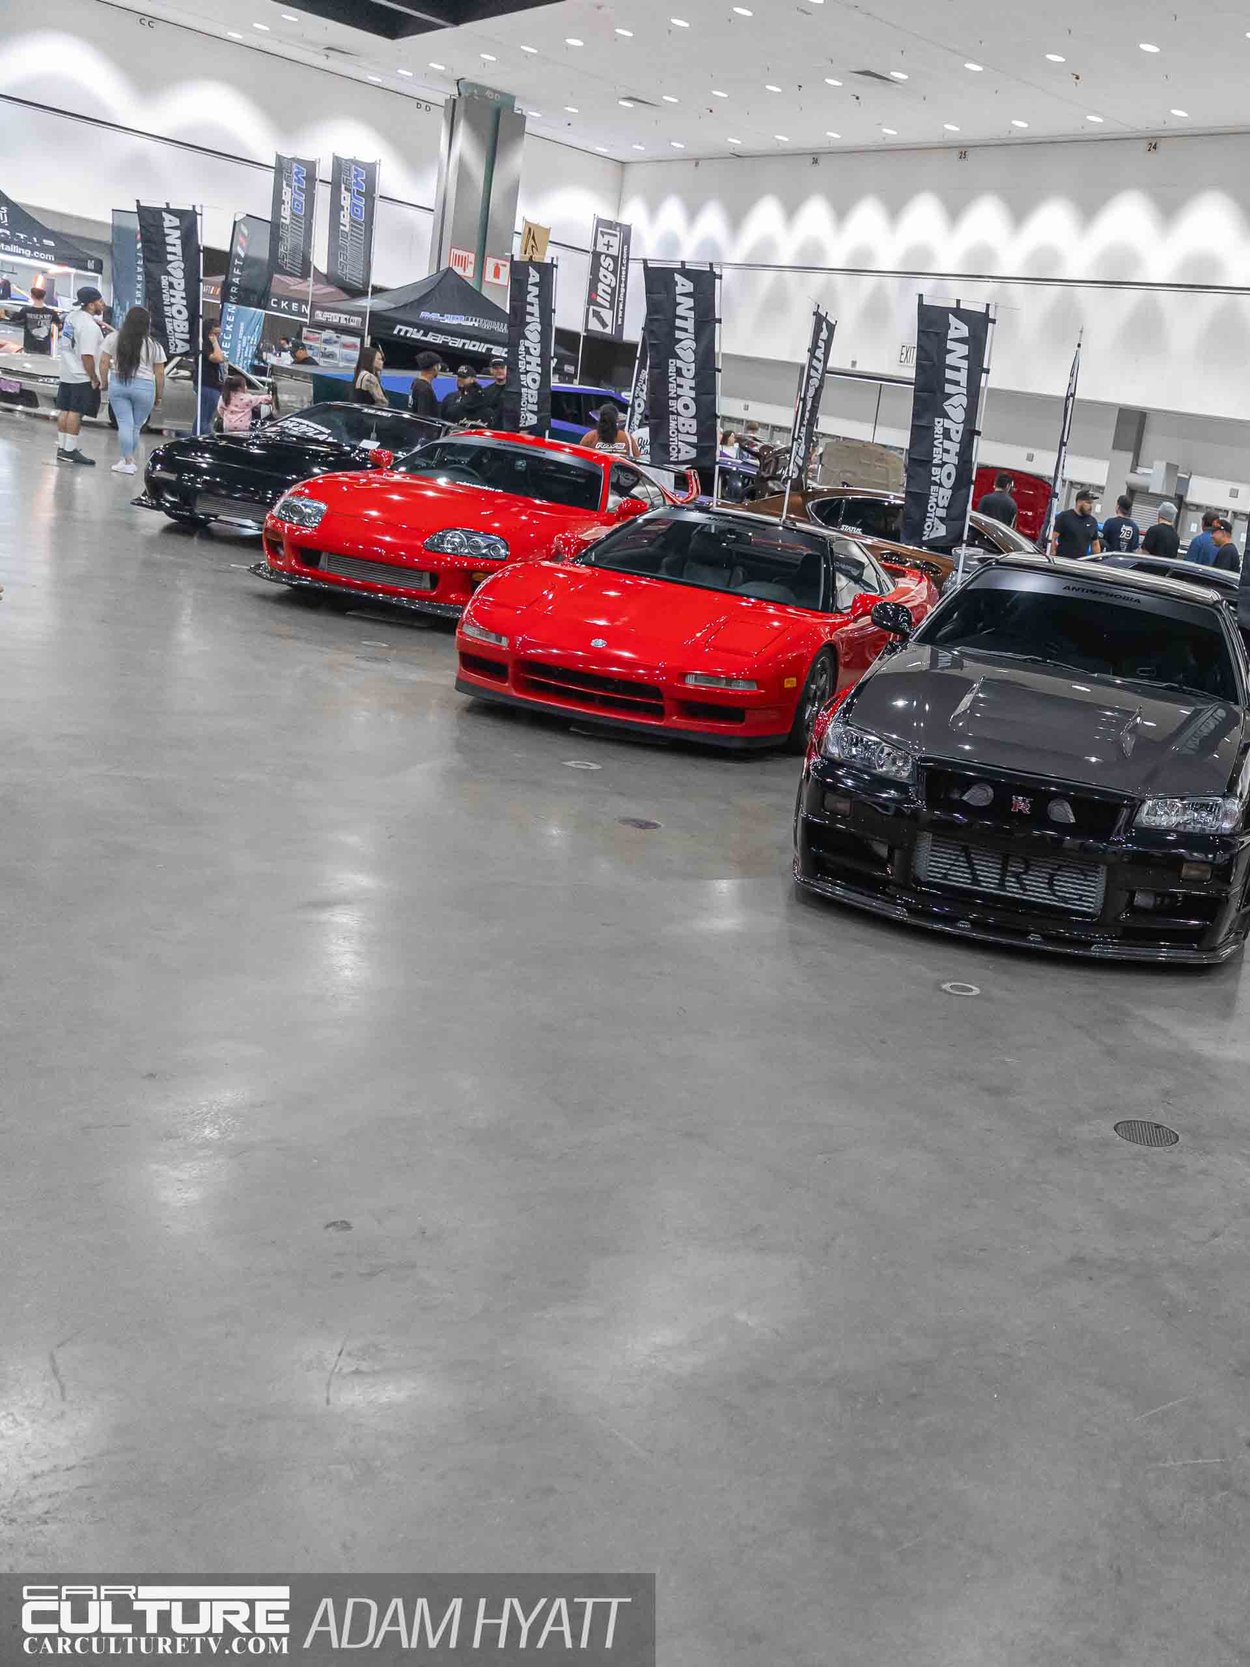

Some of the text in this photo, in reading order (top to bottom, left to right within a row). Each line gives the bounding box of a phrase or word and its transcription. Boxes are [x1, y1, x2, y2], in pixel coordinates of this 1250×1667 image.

[1147, 141, 1158, 152] 24
[0, 242, 55, 261] tailing.com
[668, 358, 679, 462] DRIVEN BY EMOTION
[922, 417, 944, 541] DRIVEN BY EMOTION
[942, 841, 1093, 903] ARC
